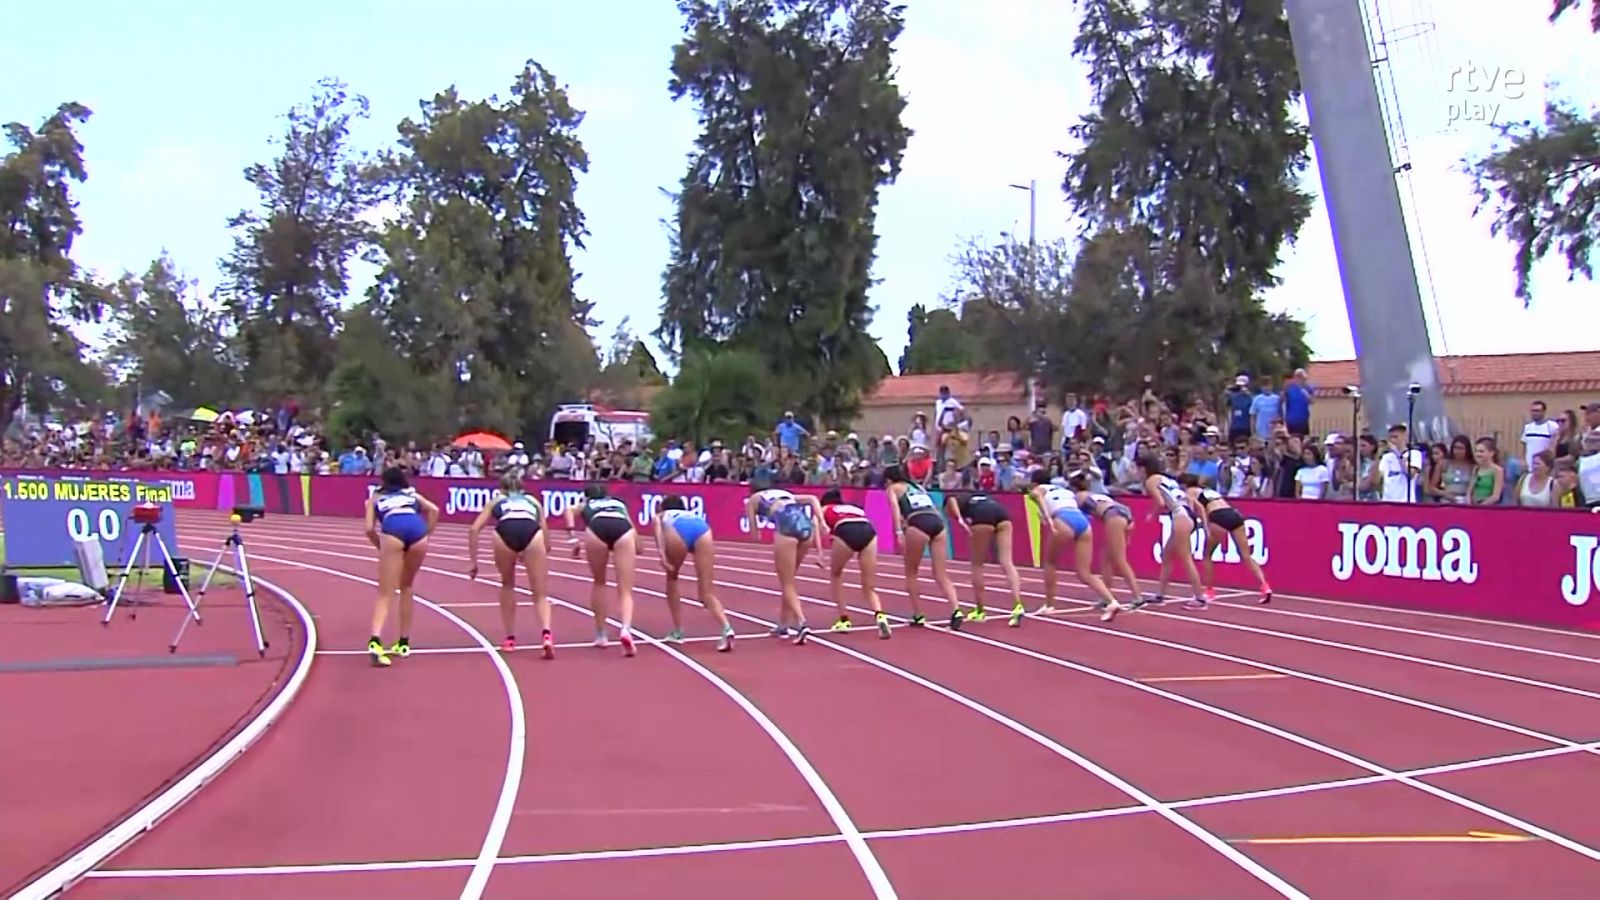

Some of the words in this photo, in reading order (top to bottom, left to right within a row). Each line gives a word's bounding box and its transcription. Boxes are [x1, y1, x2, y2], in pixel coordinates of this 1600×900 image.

[3, 482, 48, 500] 1.500
[54, 484, 130, 502] MUJERES
[136, 485, 172, 503] Final
[67, 508, 120, 542] 0.0
